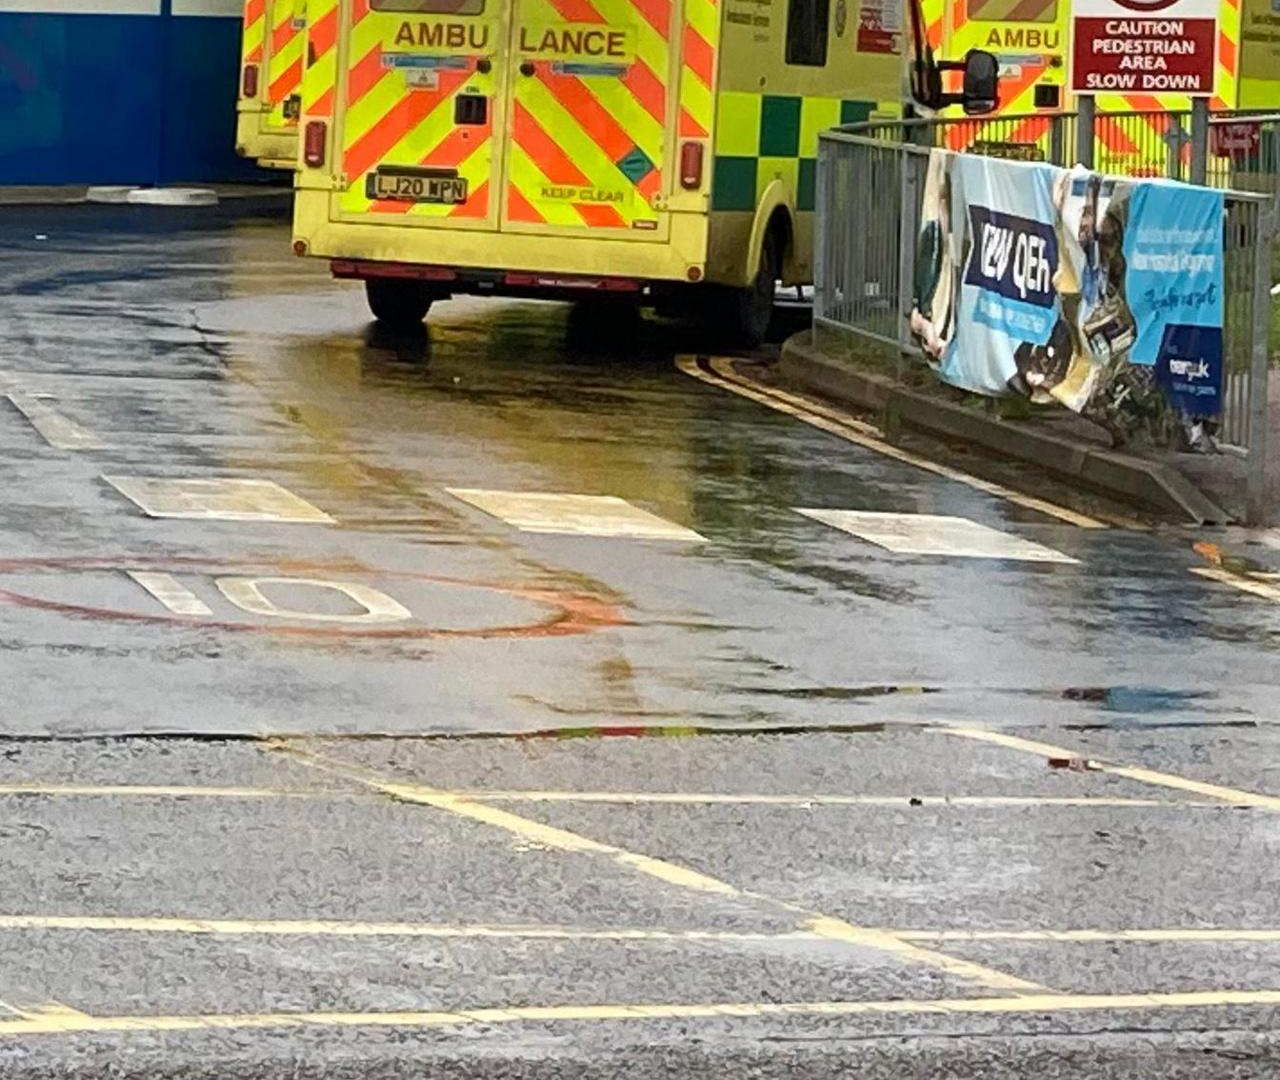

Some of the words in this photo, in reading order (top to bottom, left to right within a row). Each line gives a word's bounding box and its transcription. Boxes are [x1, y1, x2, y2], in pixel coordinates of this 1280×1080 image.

[1105, 21, 1184, 35] CAUTION
[394, 21, 489, 49] AMBU
[520, 27, 626, 56] LANCE
[985, 27, 1060, 48] AMBU
[1092, 39, 1195, 54] PEDESTRIAN
[1119, 55, 1167, 70] AREA
[1086, 73, 1136, 88] SLOW
[1143, 74, 1200, 89] DOWN
[378, 177, 423, 195] LJ20
[541, 187, 576, 200] KEEP
[579, 189, 624, 203] CLEAR
[128, 568, 413, 620] 10
